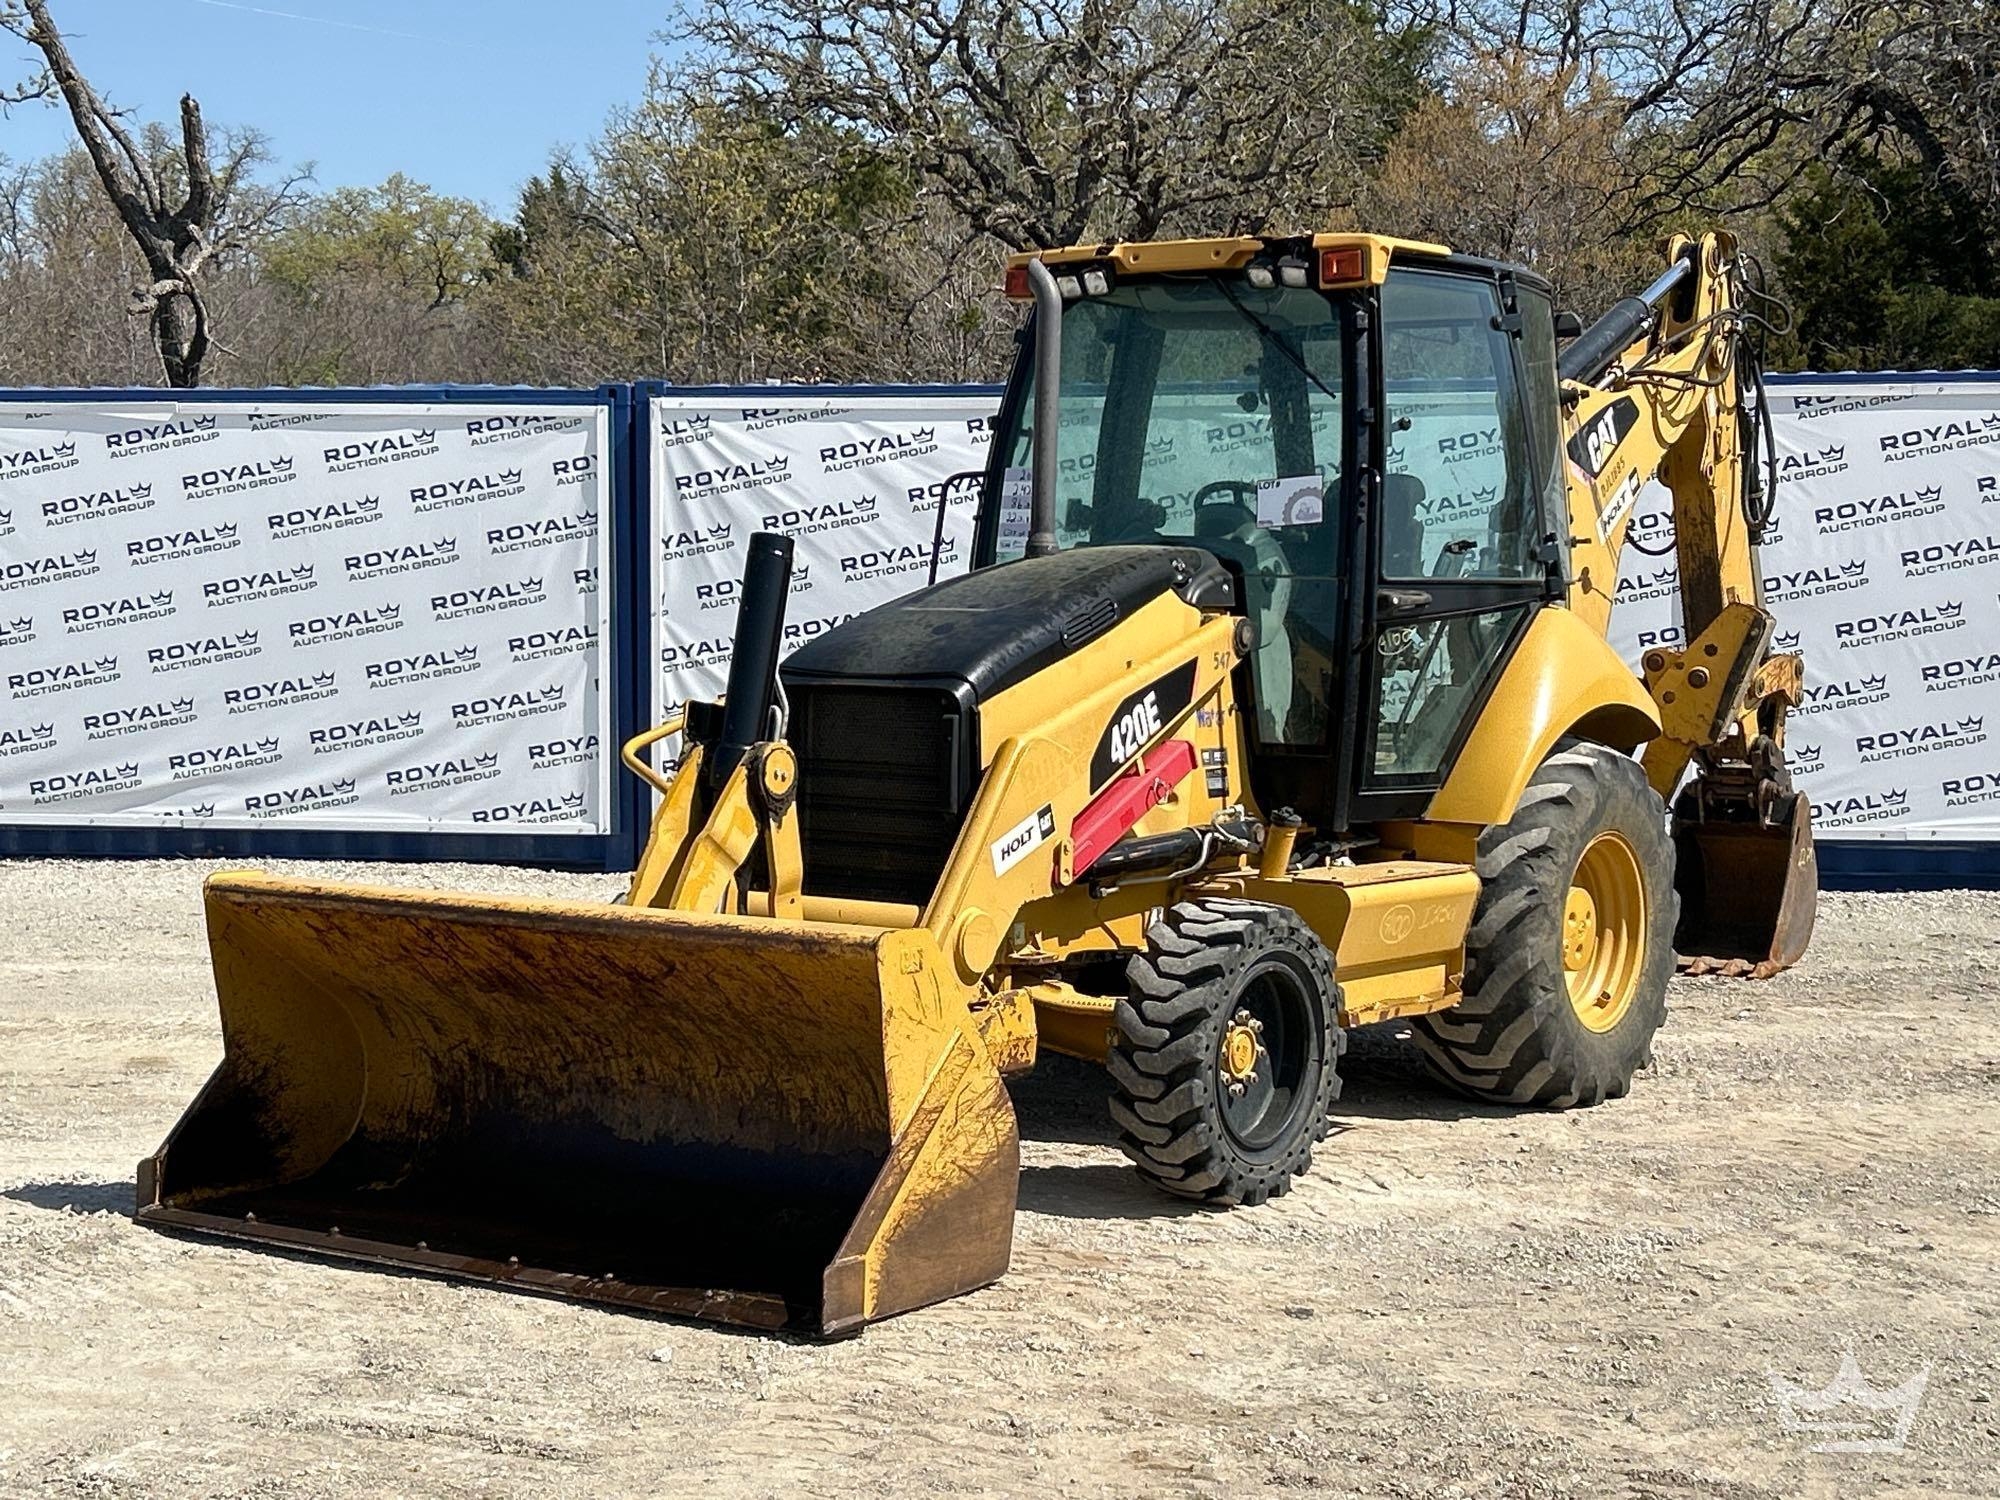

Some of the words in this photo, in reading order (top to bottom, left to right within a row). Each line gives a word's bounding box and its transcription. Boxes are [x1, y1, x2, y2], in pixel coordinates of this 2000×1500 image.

[745, 413, 808, 432] AUCTION
[1798, 401, 1867, 420] AUCTION
[105, 421, 194, 447] ROYAL
[109, 442, 170, 458] AUCTION
[171, 431, 220, 446] GROUP
[470, 428, 531, 446] AUCTION
[534, 418, 583, 434] GROUP
[1438, 428, 1497, 453] ROY
[1587, 406, 1618, 473] CAT
[1880, 421, 1981, 450] ROYAL
[0, 448, 54, 468] YAL
[324, 436, 413, 462] ROYAL
[328, 457, 389, 473] AUCTION
[390, 446, 440, 461] GROUP
[820, 435, 911, 462] ROYAL
[824, 455, 886, 473] AUCTION
[889, 444, 938, 460] GROUP
[1884, 442, 1952, 462] AUCTION
[1956, 432, 2000, 448] GROU
[0, 468, 29, 481] TION
[31, 458, 80, 473] GROUP
[182, 463, 271, 489] ROYAL
[556, 472, 597, 486] AUCTI
[674, 463, 765, 490] ROYAL
[1794, 462, 1848, 480] GROUP
[186, 484, 247, 500] AUCTION
[248, 473, 298, 488] GROUP
[410, 476, 499, 502] ROYAL
[414, 497, 475, 513] AUCTION
[476, 486, 526, 501] GROUP
[678, 483, 740, 501] AUCTION
[743, 472, 792, 488] GROUP
[908, 475, 984, 502] ROYA
[41, 489, 130, 515] ROYAL
[45, 510, 106, 526] AUCTION
[107, 499, 156, 514] GROUP
[267, 502, 356, 528] ROYAL
[1602, 490, 1627, 533] HOLT
[1815, 493, 1916, 522] ROYAL
[271, 523, 332, 539] AUCTION
[333, 512, 382, 527] GROUP
[762, 503, 853, 530] ROYAL
[831, 512, 880, 528] GROUP
[1819, 514, 1886, 534] AUCTION
[1891, 504, 1945, 520] GROUP
[126, 529, 215, 555] ROYAL
[487, 517, 576, 543] ROYAL
[491, 538, 552, 554] AUCTION
[553, 527, 598, 542] GROU
[130, 550, 191, 566] AUCTION
[192, 539, 242, 554] GROUP
[344, 544, 433, 570] ROYAL
[686, 540, 735, 556] GROUP
[840, 545, 931, 572] ROYAL
[1901, 536, 2000, 566] ROYAL
[0, 555, 75, 581] OYAL
[0, 576, 51, 591] UCTION
[52, 565, 102, 580] GROUP
[348, 565, 409, 581] AUCTION
[410, 554, 460, 569] GROUP
[844, 565, 906, 583] AUCTION
[1763, 567, 1840, 593] OYAL
[1905, 557, 1972, 577] AUCTION
[203, 570, 292, 596] ROYAL
[207, 591, 268, 607] AUCTION
[269, 580, 318, 595] GROUP
[1765, 588, 1810, 604] CTION
[1815, 578, 1869, 594] GROUP
[62, 597, 151, 623] ROYAL
[431, 584, 520, 610] ROYAL
[435, 605, 496, 621] AUCTION
[497, 594, 546, 609] GROUP
[66, 618, 127, 634] AUCTION
[128, 607, 178, 622] GROUP
[288, 610, 377, 636] ROYAL
[292, 631, 353, 647] AUCTION
[354, 620, 404, 635] GROUP
[1836, 608, 1937, 638] ROYAL
[1840, 629, 1908, 649] AUCTION
[1912, 618, 1966, 636] GROUP
[147, 636, 236, 662] ROYAL
[508, 625, 598, 651] ROYAL
[151, 657, 212, 673] AUCTION
[213, 646, 262, 661] GROUP
[365, 652, 454, 678] ROYAL
[512, 646, 573, 662] AUCTION
[663, 657, 705, 673] CTION
[1214, 651, 1231, 670] 547
[1922, 651, 2000, 680] ROYA
[7, 662, 96, 688] ROYAL
[11, 683, 72, 699] AUCTION
[73, 672, 122, 687] GROUP
[369, 673, 430, 689] AUCTION
[431, 662, 480, 677] GROUP
[1926, 672, 1994, 692] AUCTION
[224, 678, 313, 704] ROYAL
[228, 699, 289, 715] AUCTION
[290, 688, 340, 703] GROUP
[451, 691, 540, 717] ROYAL
[1803, 681, 1861, 702] YAL
[83, 703, 172, 729] ROYAL
[455, 712, 516, 728] AUCTION
[517, 701, 566, 716] GROUP
[1786, 702, 1832, 719] CTION
[1836, 692, 1890, 708] GROUP
[87, 724, 148, 740] AUCTION
[149, 713, 198, 728] GROUP
[309, 717, 398, 743] ROYAL
[1111, 690, 1161, 763] 420E
[1857, 722, 1958, 752] ROYAL
[9, 739, 58, 754] GROUP
[313, 738, 374, 754] AUCTION
[375, 727, 424, 742] GROUP
[528, 733, 598, 759] ROYA
[1861, 743, 1928, 763] AUCTION
[1933, 732, 1987, 750] GROUP
[168, 743, 257, 769] ROYAL
[172, 764, 233, 780] AUCTION
[234, 753, 284, 768] GROUP
[532, 754, 593, 770] AUCTION
[28, 768, 117, 794] ROYAL
[386, 759, 475, 785] ROYAL
[390, 780, 451, 796] AUCTION
[452, 769, 502, 784] GROUP
[1942, 773, 2000, 796] ROY
[32, 789, 93, 805] AUCTION
[94, 778, 144, 793] GROUP
[244, 784, 333, 810] ROYAL
[248, 805, 309, 818] AUCTION
[310, 794, 360, 809] GROUP
[538, 808, 588, 823] GROUP
[1857, 806, 1911, 822] GROUP
[1001, 826, 1034, 861] HOLT
